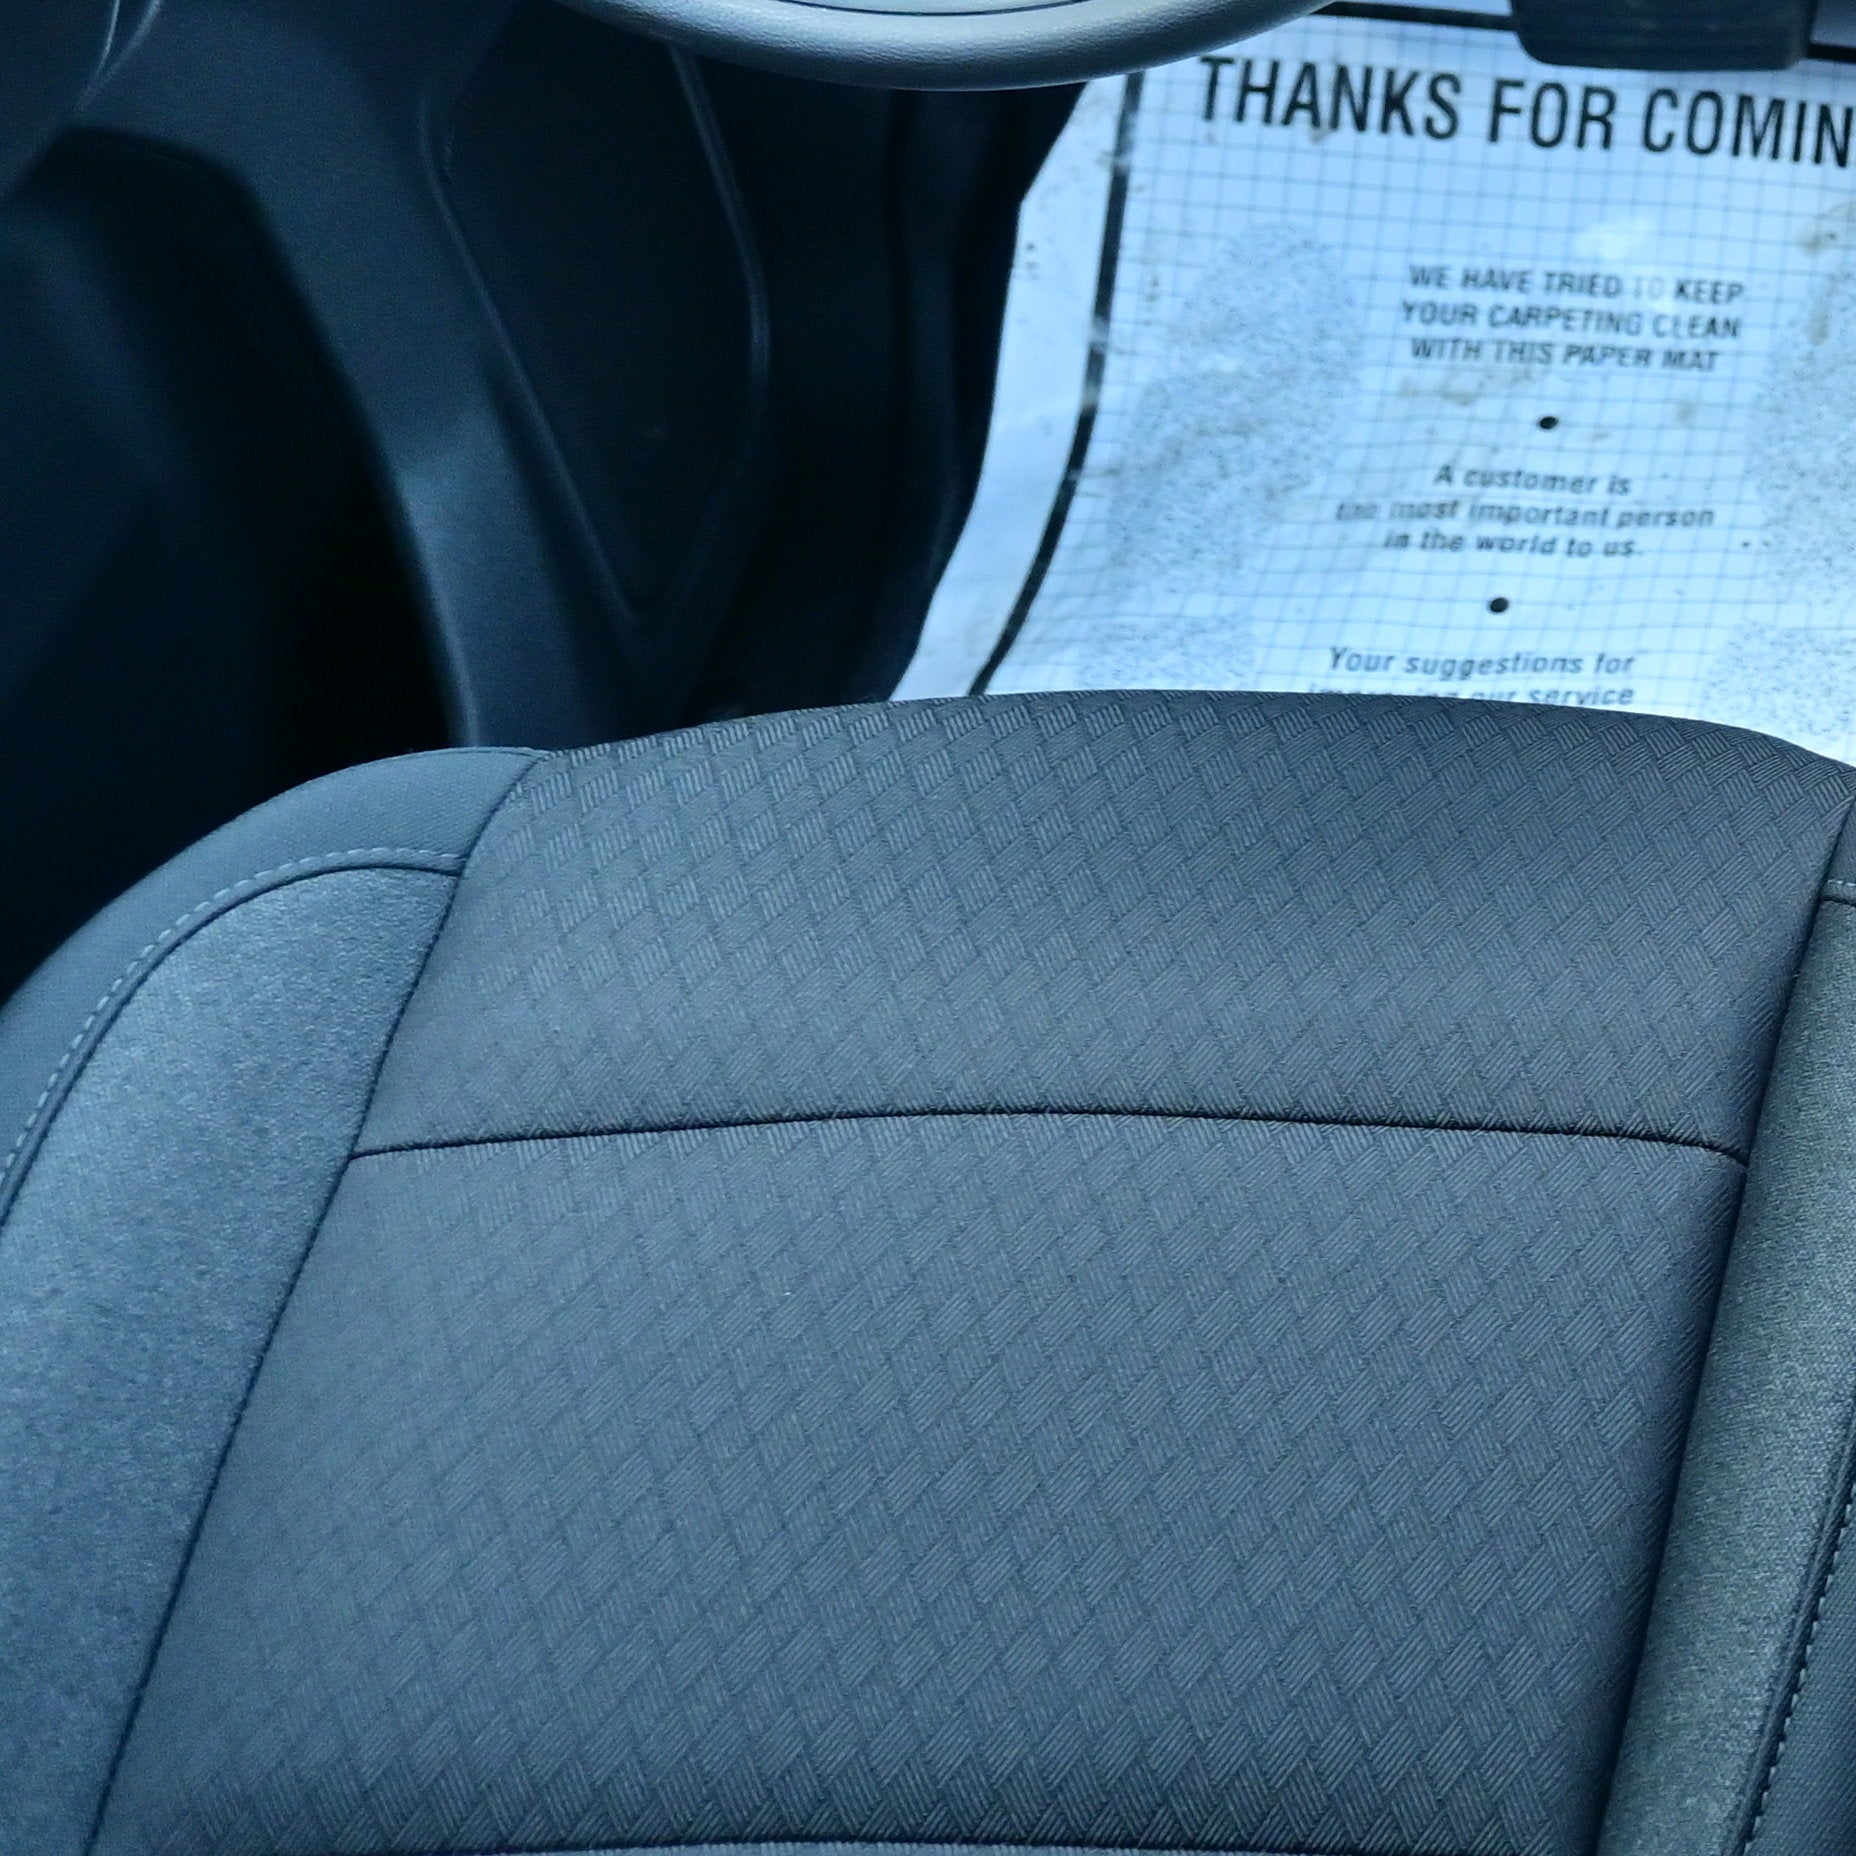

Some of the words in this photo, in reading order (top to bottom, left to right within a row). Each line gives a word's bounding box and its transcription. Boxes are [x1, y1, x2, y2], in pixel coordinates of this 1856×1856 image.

[1201, 56, 1462, 140] THANKS
[1488, 78, 1618, 150] FOR
[1409, 265, 1451, 289] WE
[1461, 268, 1533, 294] HAVE
[1542, 272, 1622, 298] TRIED
[1675, 278, 1744, 305] KEEP
[1401, 300, 1479, 326] YOUR
[1488, 303, 1642, 337] CARPETING
[1651, 314, 1743, 339] CLEAN
[1410, 338, 1482, 361] WITH
[1494, 340, 1554, 365] THIS
[1562, 344, 1651, 367] PAPER
[1661, 349, 1720, 372] MAT
[1433, 464, 1453, 485] A
[1462, 468, 1598, 494] customer
[1606, 474, 1631, 495] is
[1389, 500, 1462, 519] most
[1468, 502, 1609, 527] important
[1615, 508, 1716, 529] person
[1383, 530, 1410, 549] in
[1419, 529, 1464, 552] the
[1476, 536, 1556, 556] world
[1565, 537, 1593, 558] to
[1329, 647, 1395, 673] Your
[1404, 651, 1584, 681] suggestions
[1593, 653, 1635, 674] for
[1529, 687, 1634, 707] service
